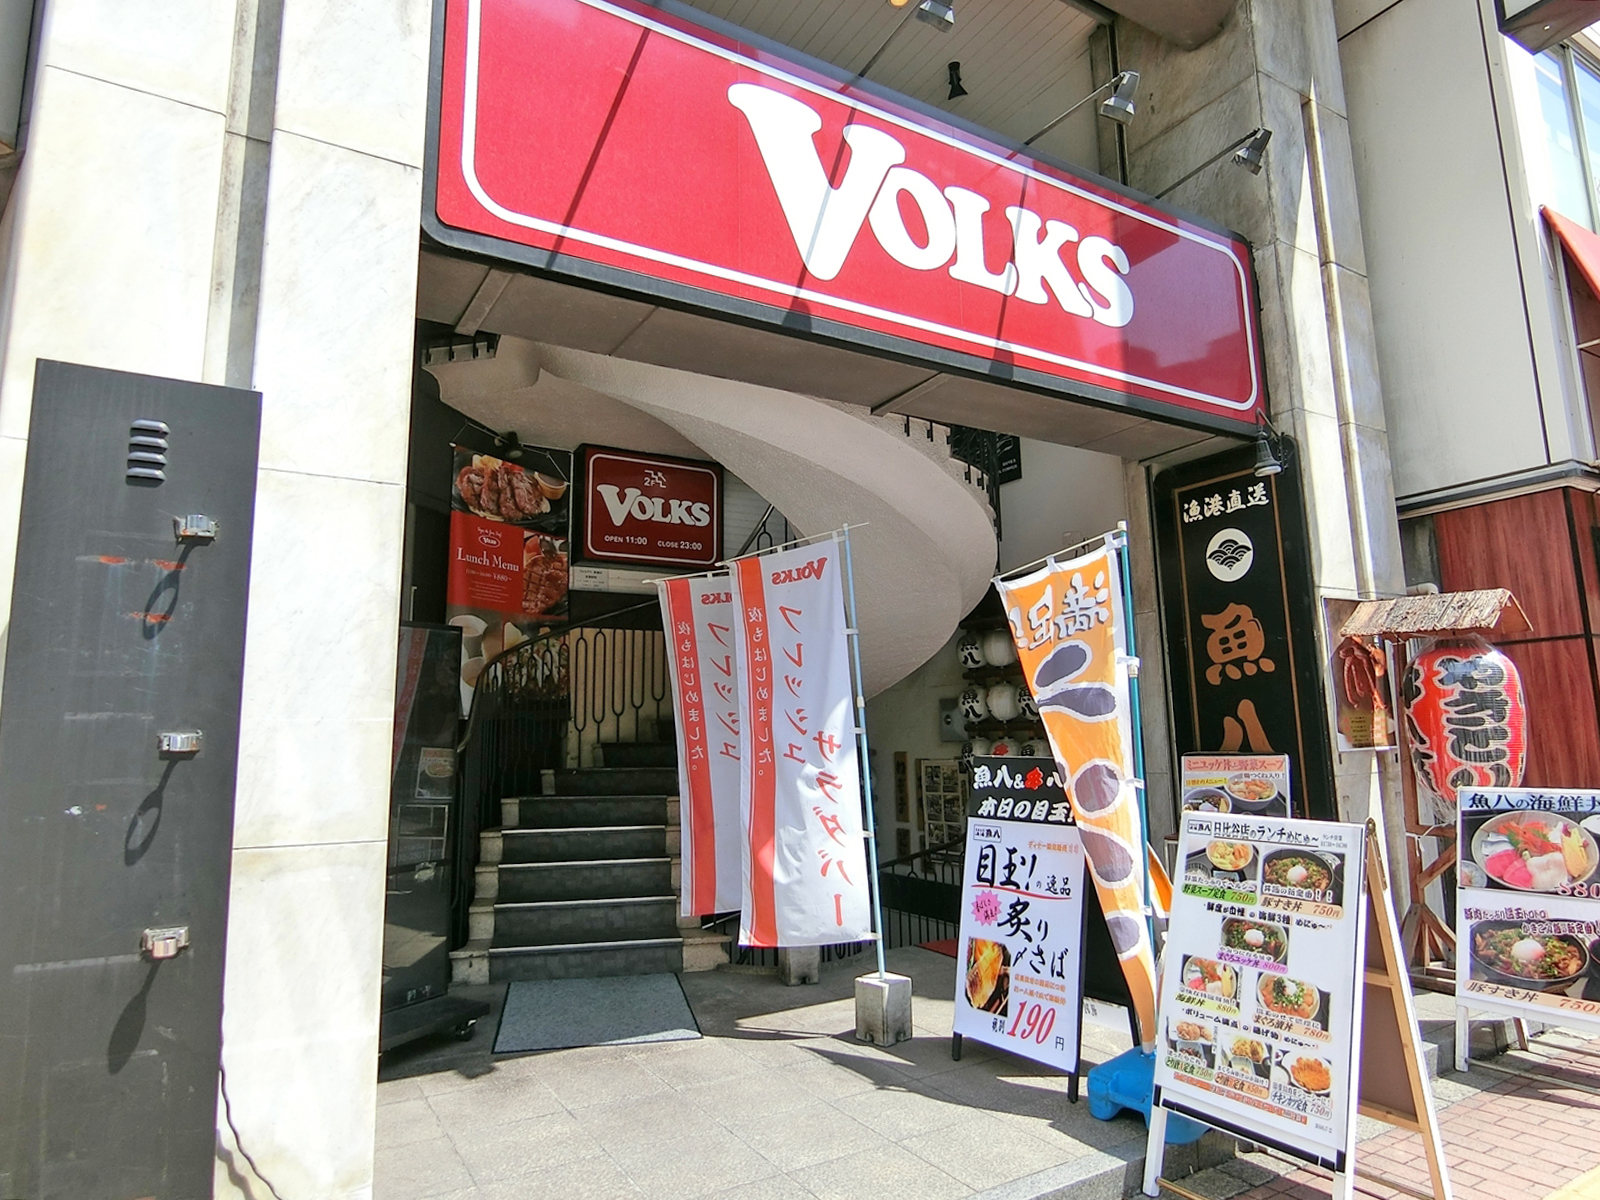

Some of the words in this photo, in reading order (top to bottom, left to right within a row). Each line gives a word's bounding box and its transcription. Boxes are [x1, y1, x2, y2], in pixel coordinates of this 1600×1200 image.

[728, 83, 1135, 328] VOLKS
[644, 477, 655, 487] 2F
[597, 484, 710, 527] VOLKS
[1183, 481, 1269, 523] 漁港直送
[604, 535, 623, 543] OPEN
[625, 536, 648, 545] 11:00
[657, 540, 679, 549] CLOSE
[680, 541, 702, 551] 23:00
[457, 547, 490, 566] Lunch
[492, 555, 519, 572] Menu
[1201, 602, 1275, 752] 魚八
[1230, 891, 1255, 903] 750円
[1261, 896, 1303, 912] 豚すき丼
[1313, 904, 1341, 918] 750円
[1263, 961, 1287, 973] 800円
[1175, 993, 1206, 1007] 海鮮丼
[1466, 981, 1540, 1003] 豚すき丼
[1558, 998, 1600, 1014] 750
[1007, 1000, 1056, 1044] 190
[1055, 1035, 1065, 1051] 円
[1303, 1027, 1329, 1040] 780円
[1310, 1103, 1330, 1118] 750円
